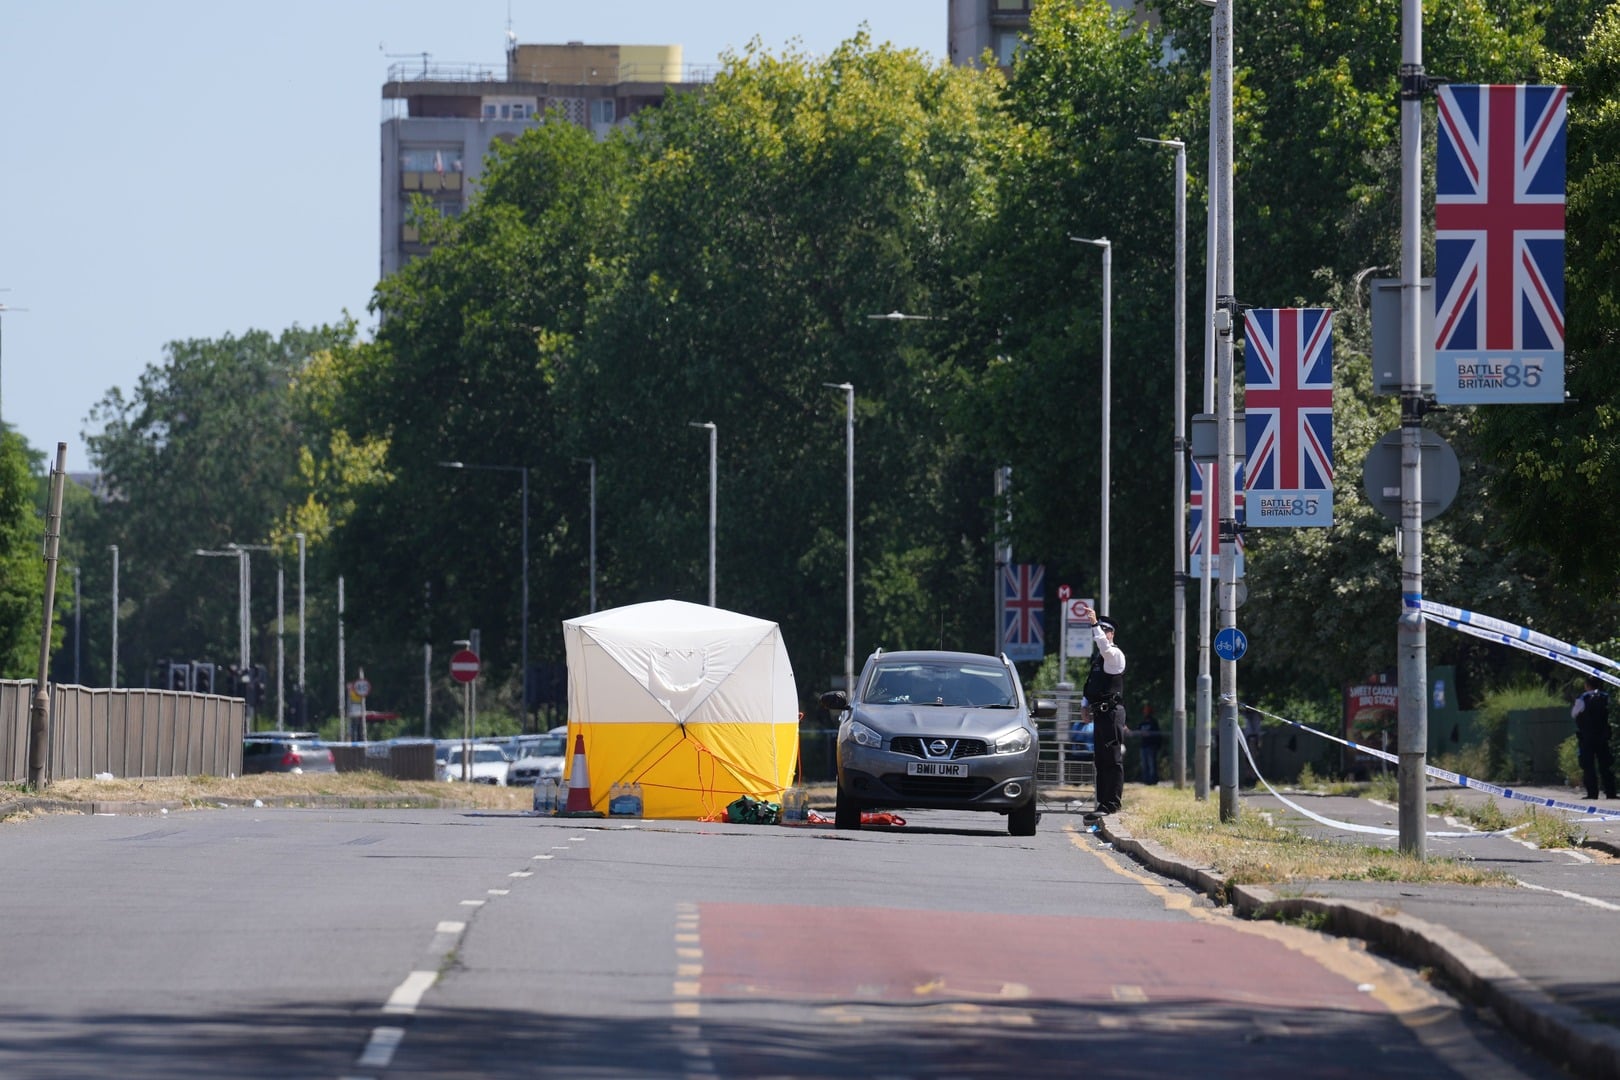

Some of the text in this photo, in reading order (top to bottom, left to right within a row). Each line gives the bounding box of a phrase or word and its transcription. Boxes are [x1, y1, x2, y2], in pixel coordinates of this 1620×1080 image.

[1458, 364, 1502, 375] BATTLE
[1503, 364, 1543, 388] 85
[1458, 378, 1503, 389] BRITAIN
[1261, 499, 1291, 507] BATTLE
[1291, 499, 1319, 516] 85
[1058, 586, 1070, 598] M
[938, 764, 960, 776] UMR
